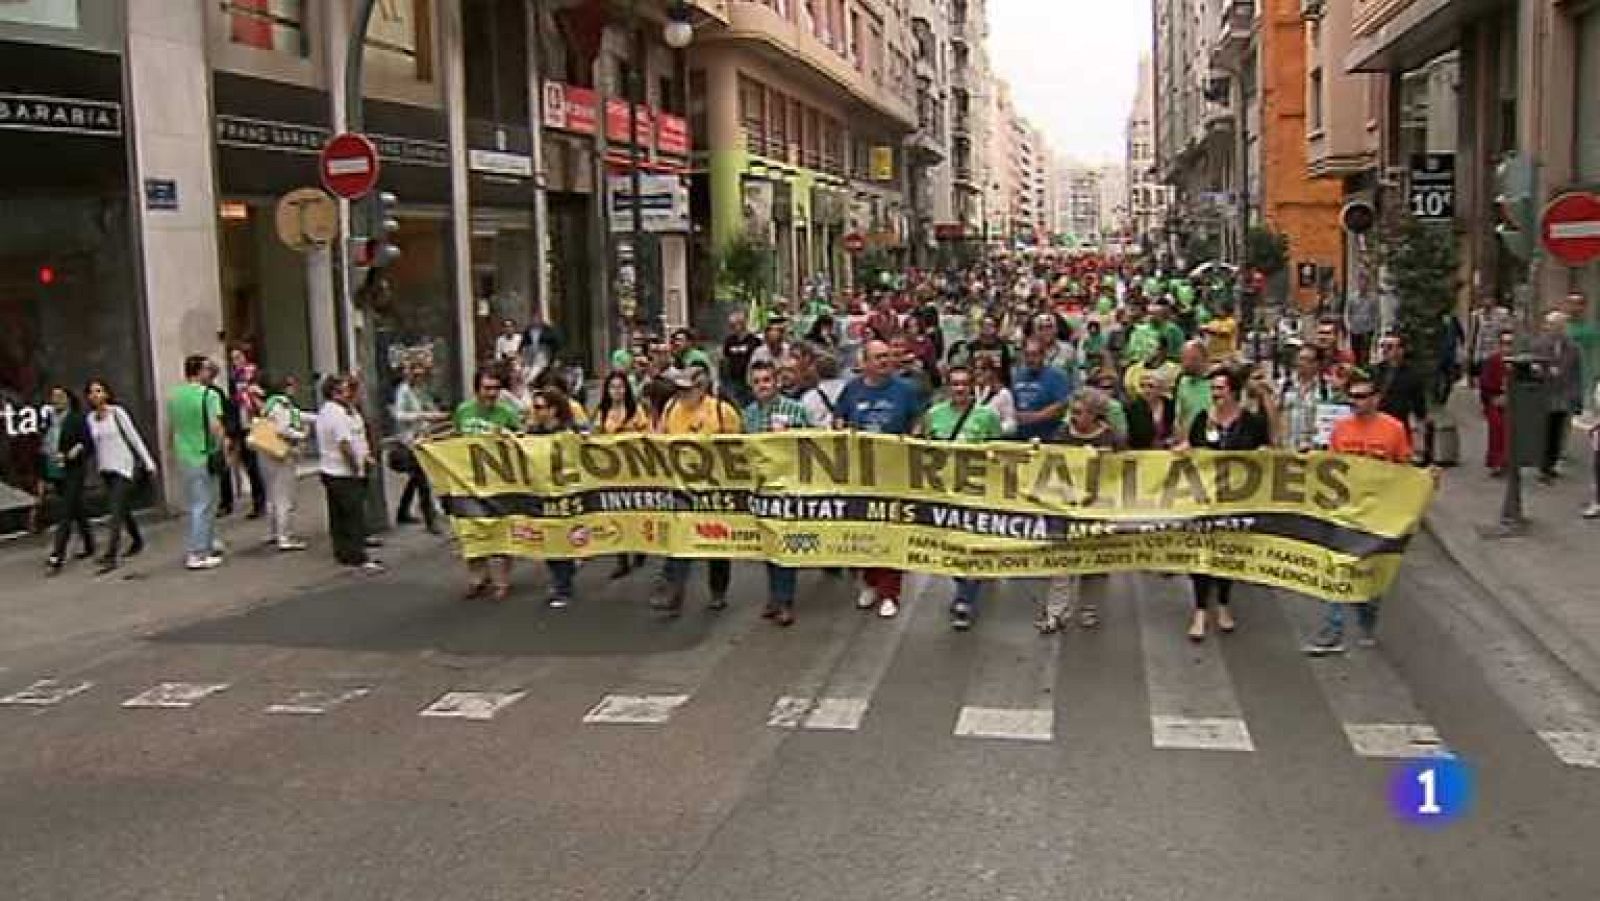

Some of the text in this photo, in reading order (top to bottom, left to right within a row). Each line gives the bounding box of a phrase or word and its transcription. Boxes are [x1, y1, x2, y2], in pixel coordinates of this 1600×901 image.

[468, 438, 532, 487] NI
[798, 437, 876, 486] NI
[908, 445, 1351, 509] RETALLADES
